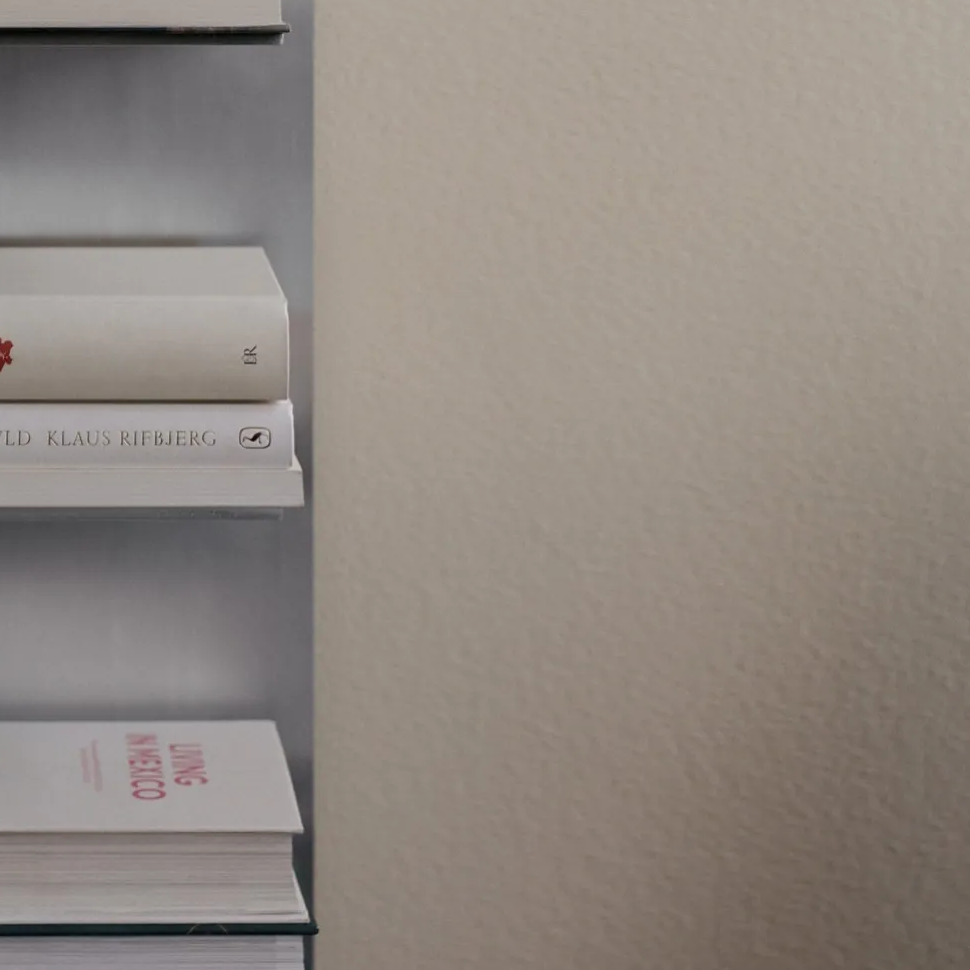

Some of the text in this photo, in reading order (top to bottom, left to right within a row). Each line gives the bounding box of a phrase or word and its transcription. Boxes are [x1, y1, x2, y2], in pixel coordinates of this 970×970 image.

[47, 430, 111, 447] KLAUS
[119, 430, 217, 447] RIFBJERG
[125, 733, 167, 801] IN MEXICO
[168, 742, 209, 787] LIVING
